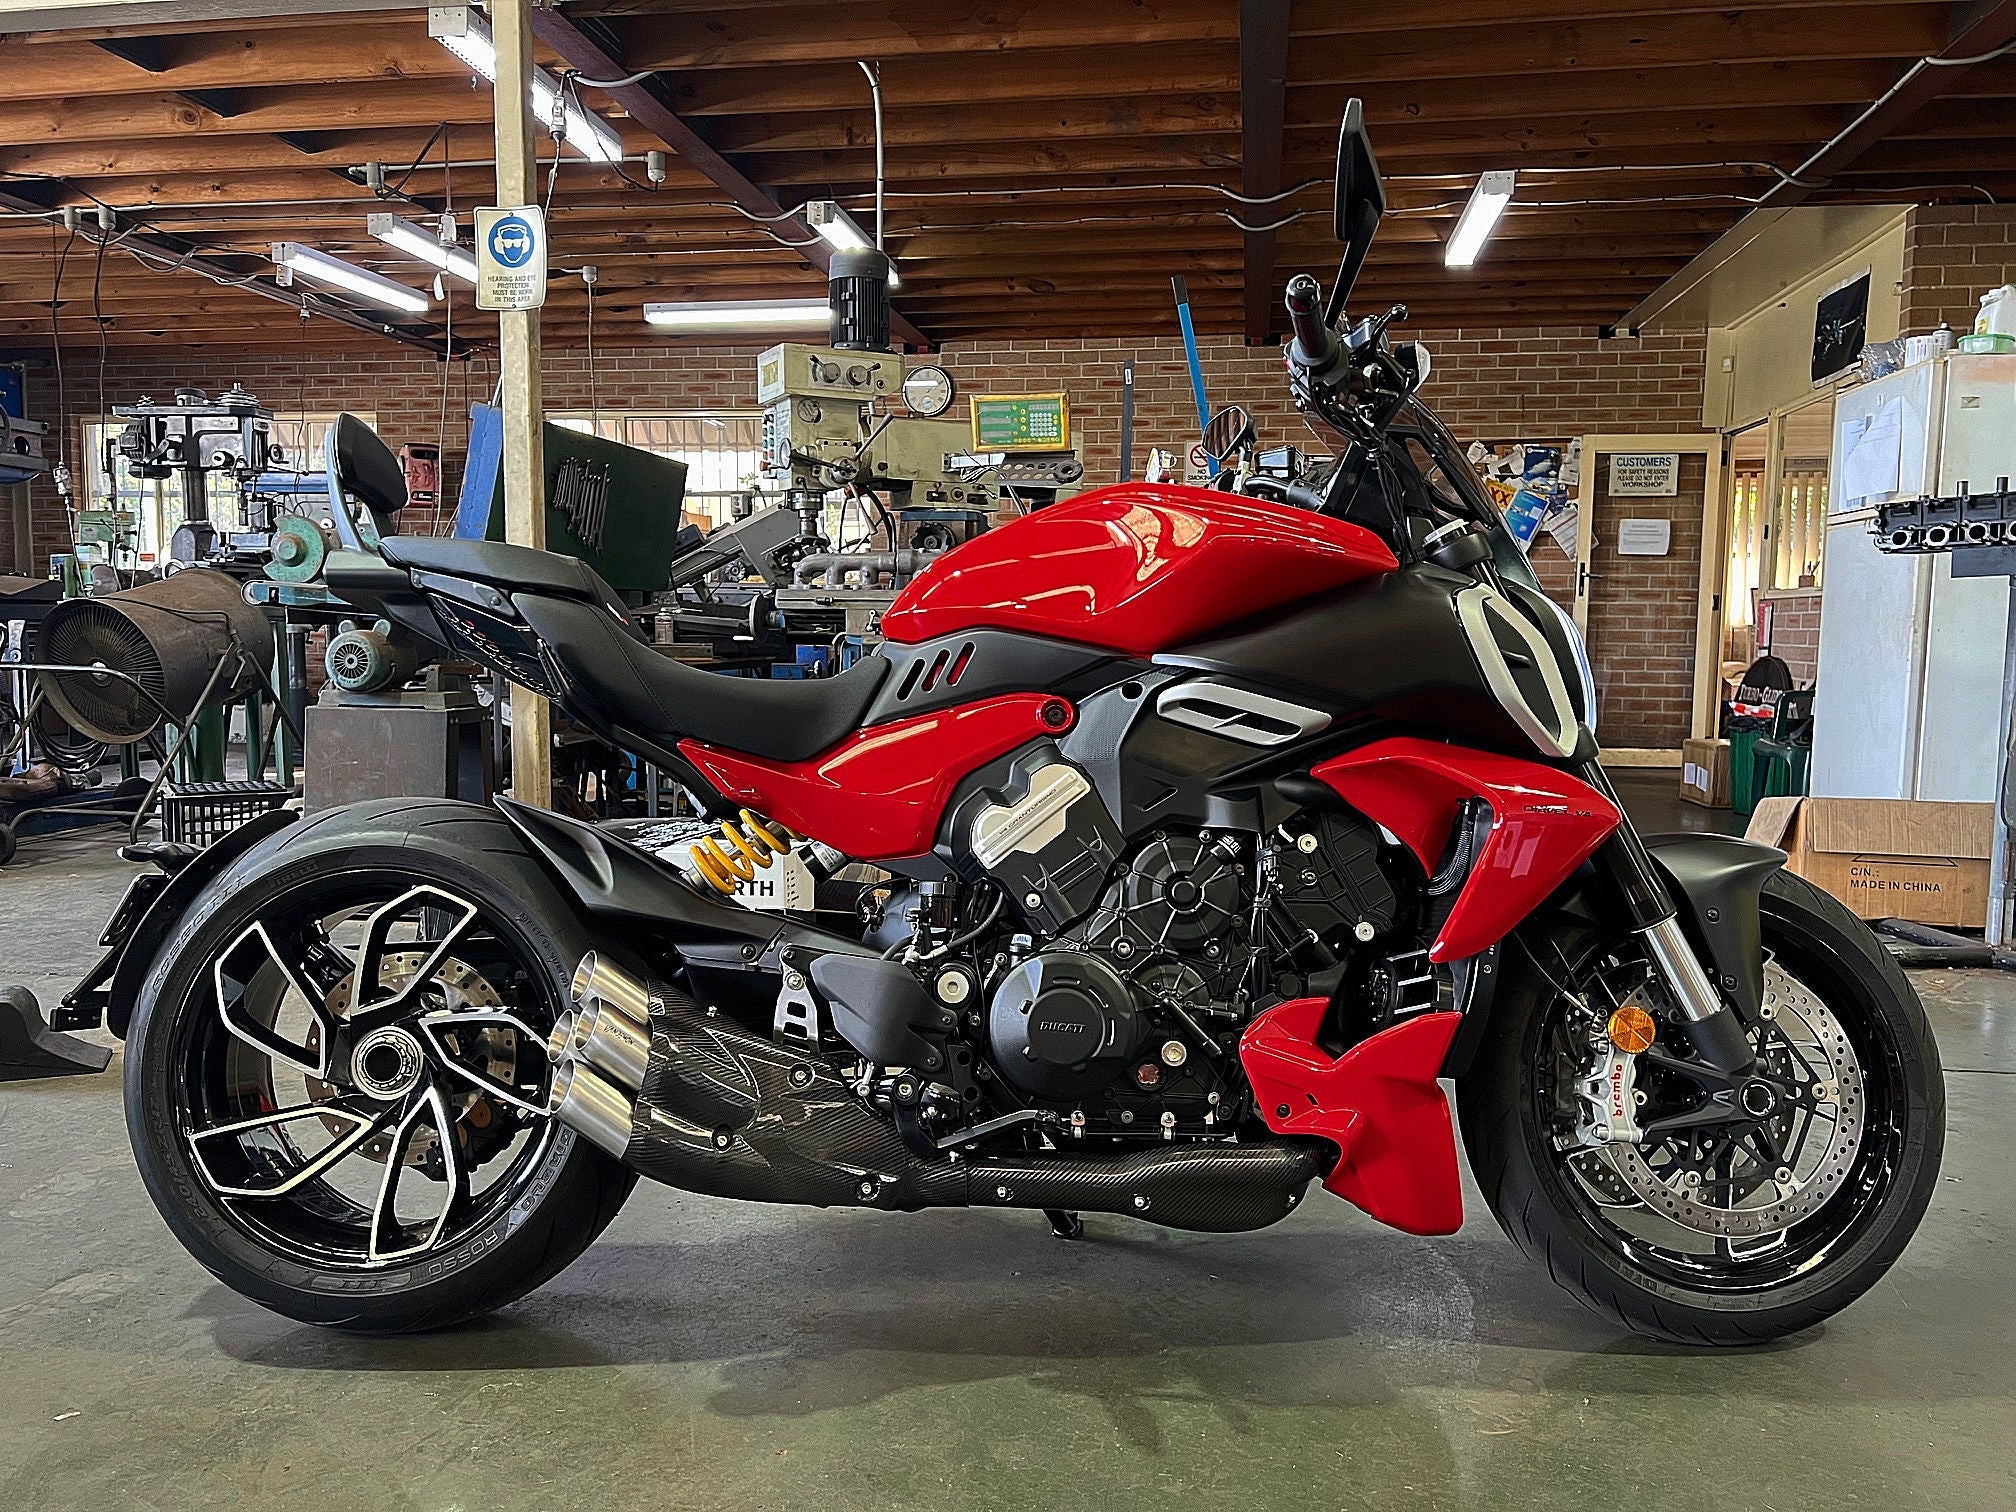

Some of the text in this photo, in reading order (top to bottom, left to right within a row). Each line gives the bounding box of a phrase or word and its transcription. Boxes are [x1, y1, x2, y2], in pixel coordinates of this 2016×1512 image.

[1616, 457, 1672, 467] CUSTOMERS
[1850, 867, 1880, 878] C/N.:
[734, 880, 774, 896] RTH
[1850, 879, 1941, 892] MADE IN CHINA
[1039, 1021, 1086, 1034] DUCATI
[1611, 1064, 1623, 1117] brembo
[520, 1127, 574, 1211] DIABLO
[428, 1230, 499, 1277] ROSSO
